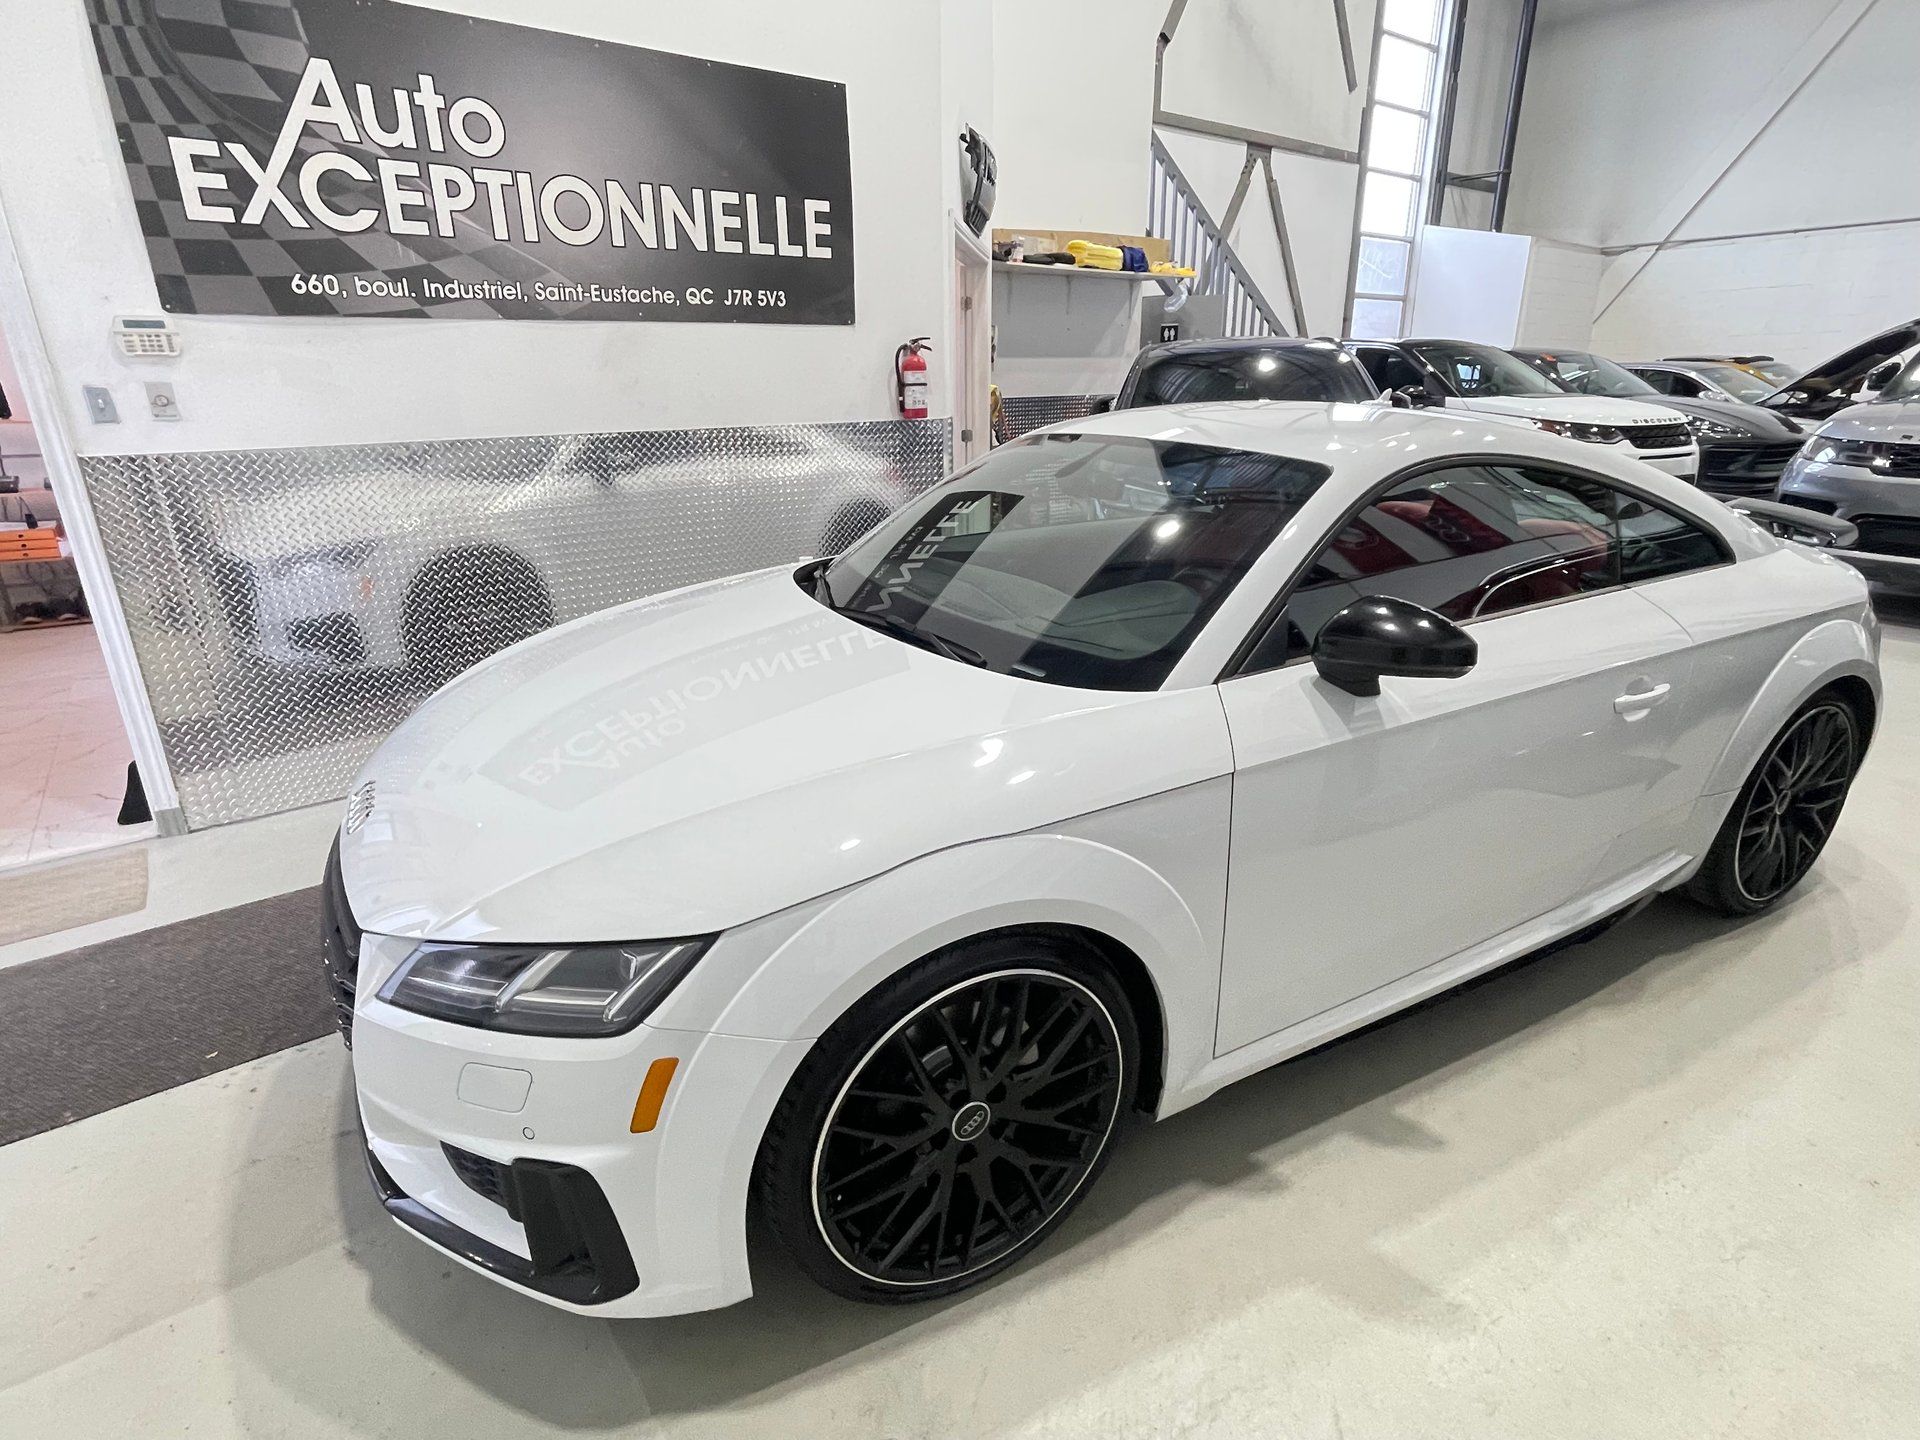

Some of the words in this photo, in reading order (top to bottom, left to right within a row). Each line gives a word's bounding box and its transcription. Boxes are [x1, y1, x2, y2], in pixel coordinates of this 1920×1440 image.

[286, 57, 506, 158] Auto
[167, 136, 832, 259] EXCEPTIONNELLE
[290, 273, 348, 298] 660,
[354, 276, 416, 298] boul.
[422, 278, 528, 302] Industriel,
[534, 282, 680, 306] Saint-Eustache,
[685, 287, 714, 305] QC
[724, 289, 752, 306] J7R
[757, 290, 787, 307] 5V3
